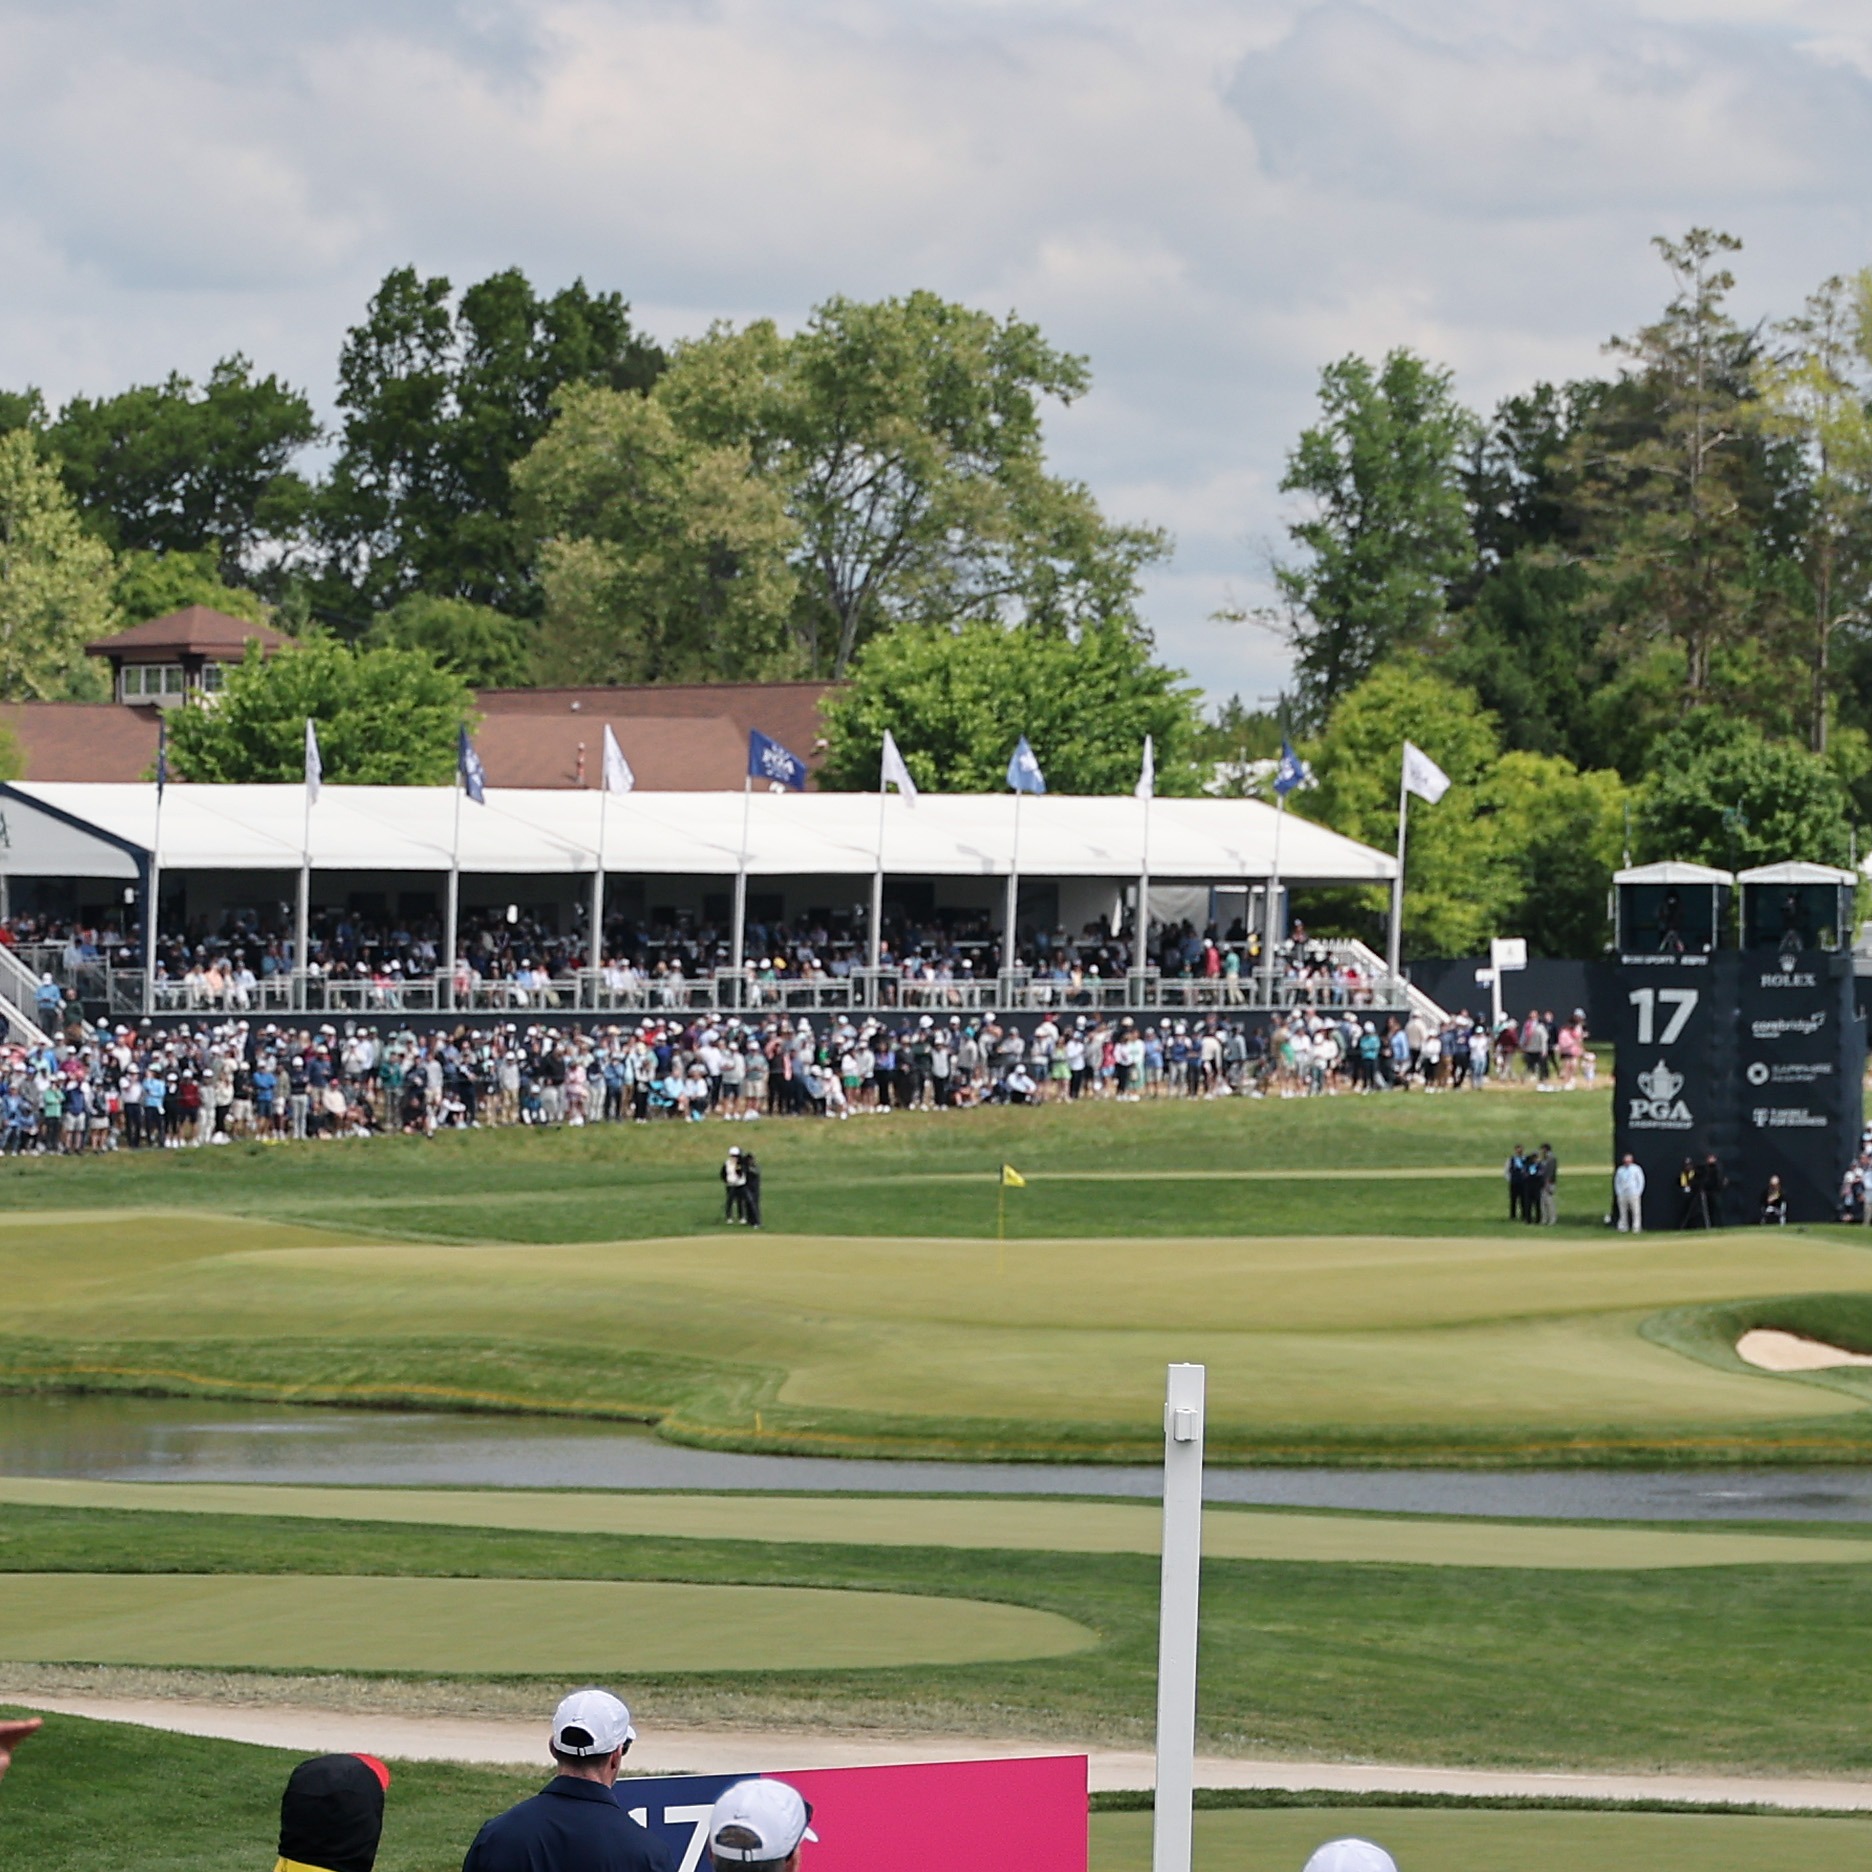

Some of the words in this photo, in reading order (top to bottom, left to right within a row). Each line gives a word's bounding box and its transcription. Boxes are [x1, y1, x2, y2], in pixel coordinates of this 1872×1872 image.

[1761, 973, 1816, 988] ROLEX
[1628, 987, 1699, 1044] 17
[1629, 1098, 1693, 1120] PGA
